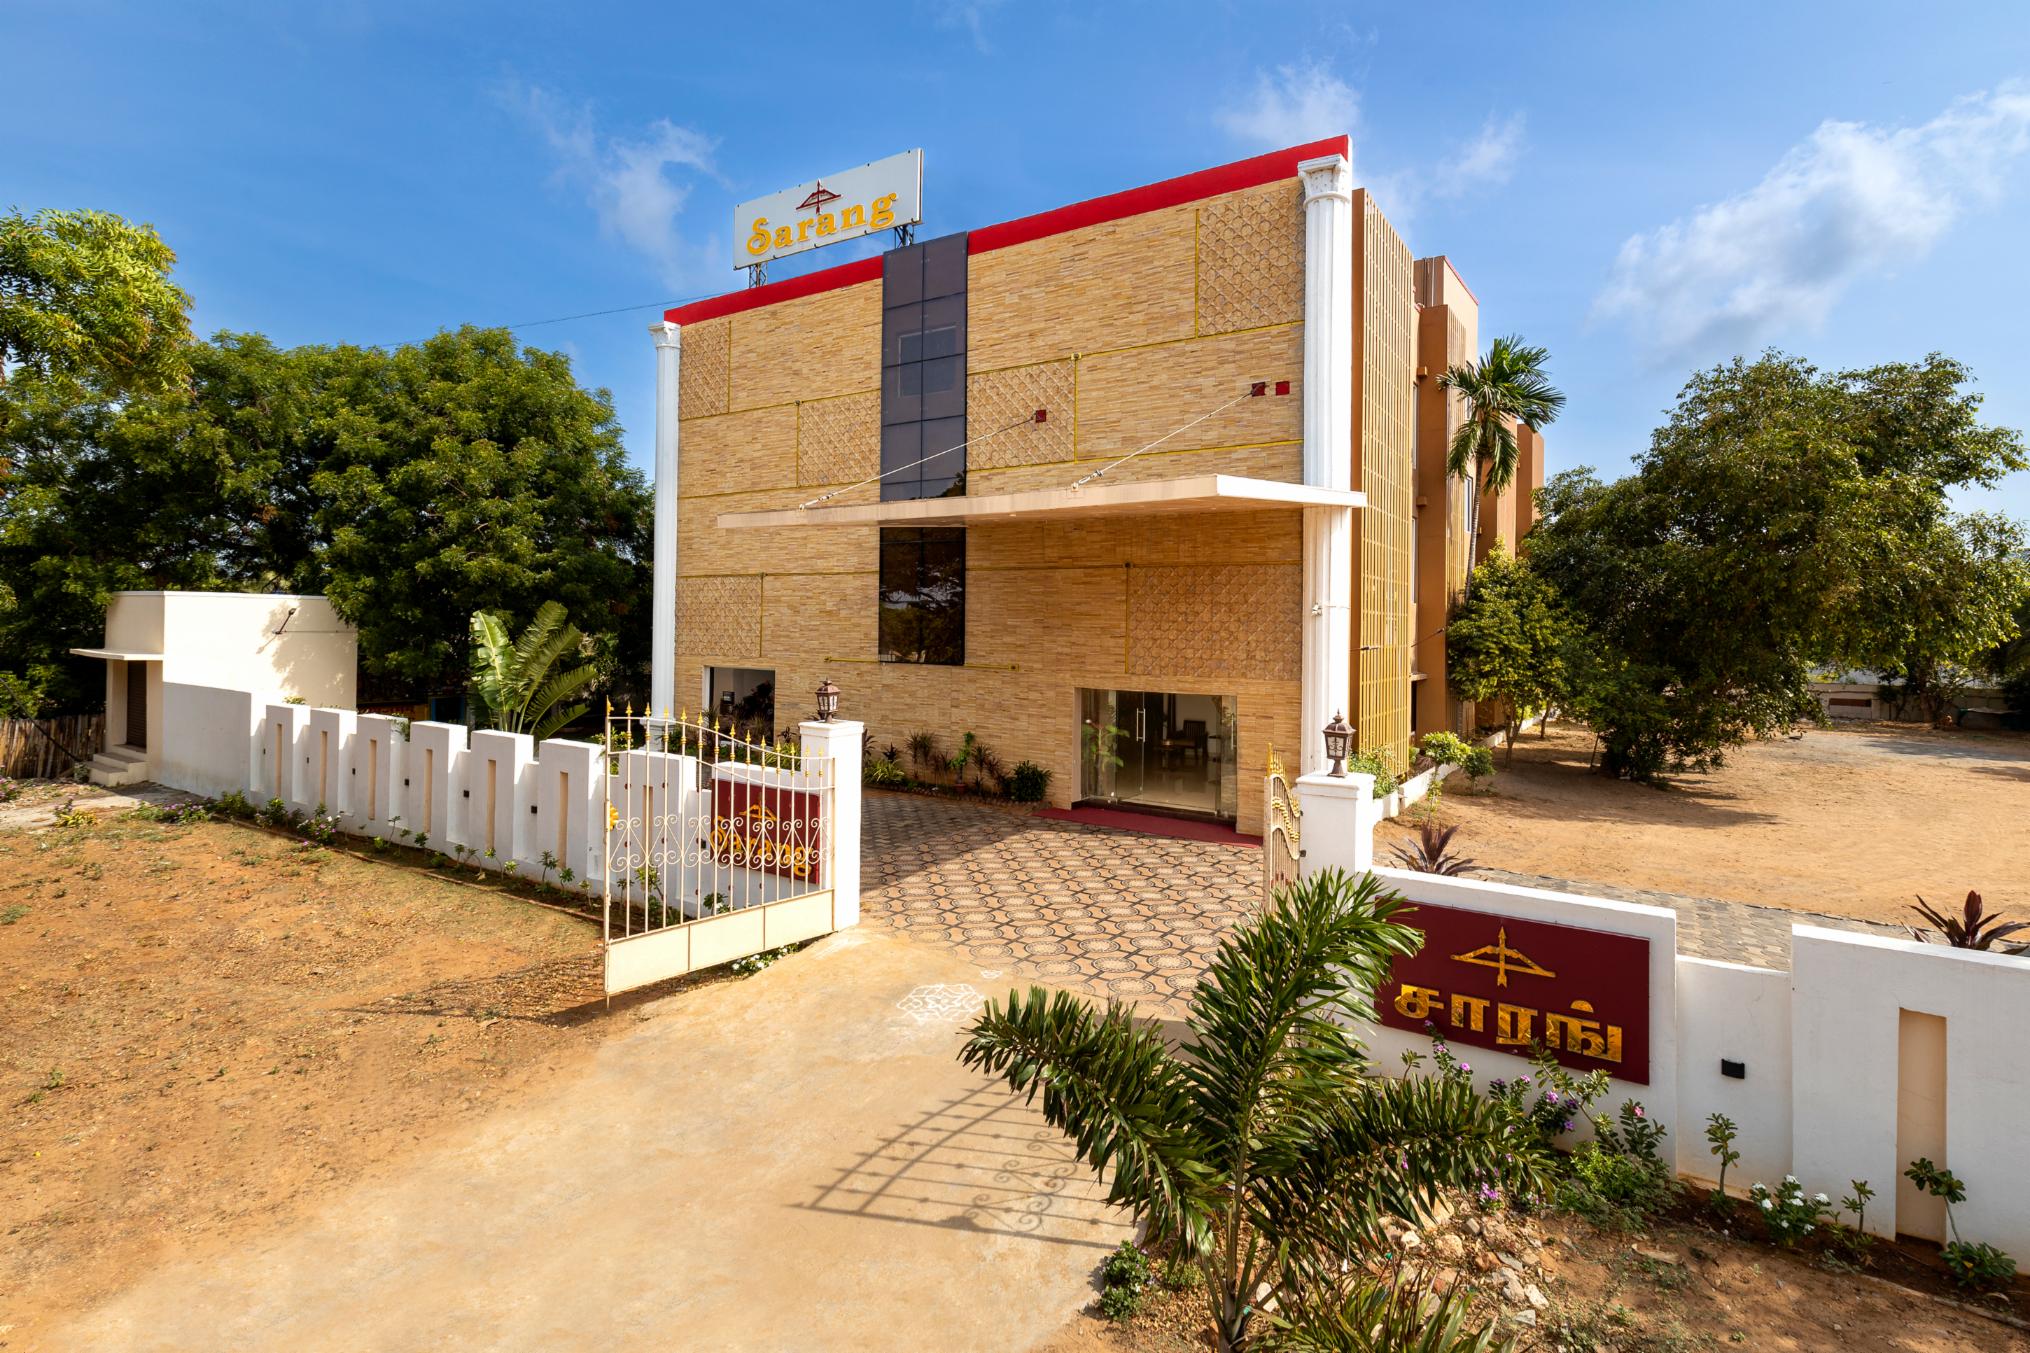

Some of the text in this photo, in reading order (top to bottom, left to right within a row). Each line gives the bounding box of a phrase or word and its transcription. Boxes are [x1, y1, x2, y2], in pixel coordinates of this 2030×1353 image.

[746, 193, 897, 255] Sarang
[710, 816, 814, 876] Sarang
[1394, 983, 1622, 1063] சாரங்
